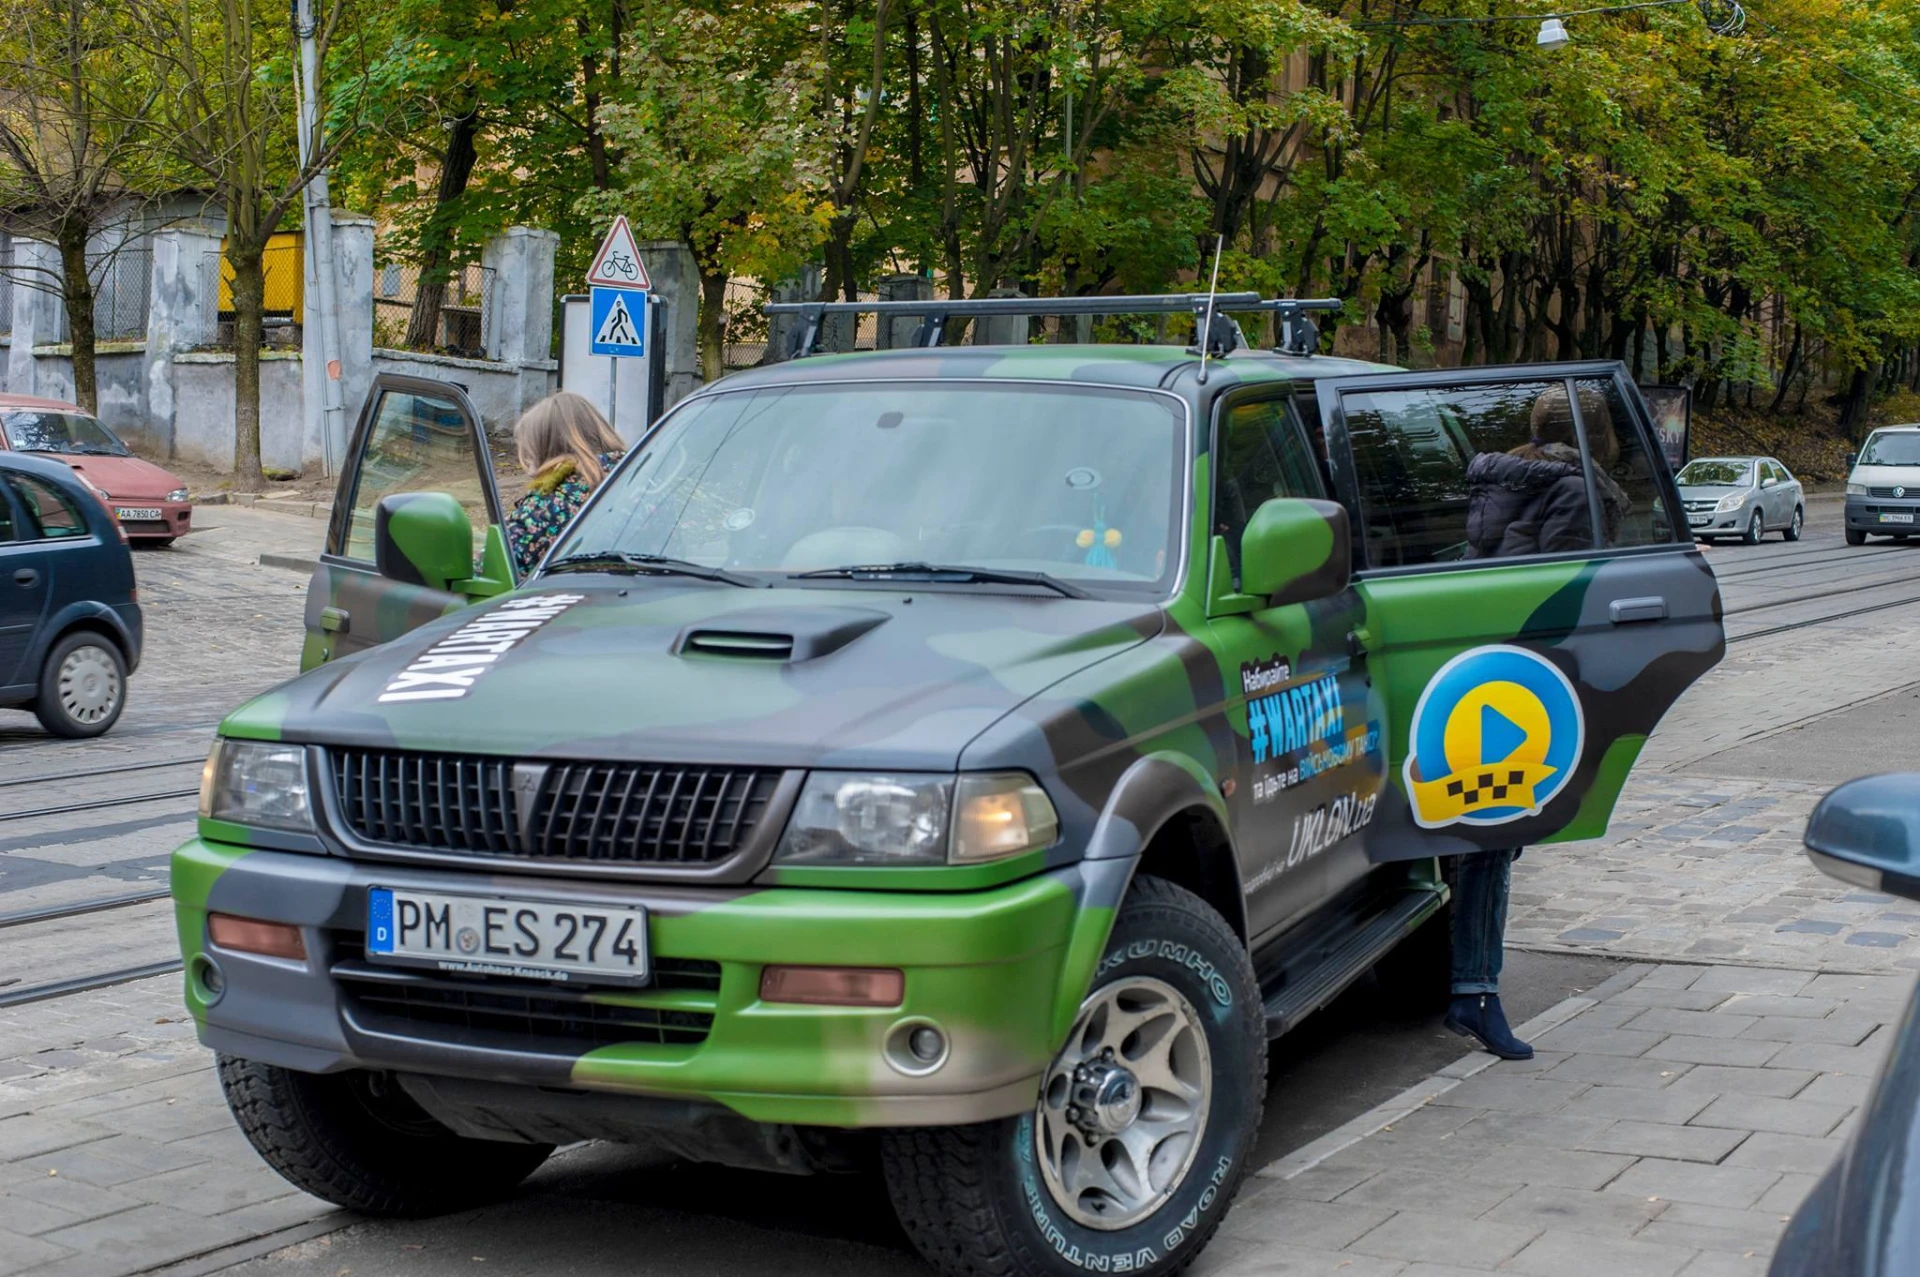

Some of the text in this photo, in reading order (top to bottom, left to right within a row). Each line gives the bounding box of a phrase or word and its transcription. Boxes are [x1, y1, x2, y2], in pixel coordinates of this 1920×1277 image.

[1656, 427, 1680, 444] SKY
[121, 509, 131, 518] AA
[132, 509, 149, 518] 7850
[378, 594, 585, 702] #WARTAXI
[1242, 661, 1290, 693] Набирайте
[1249, 675, 1342, 765] #WARTAXI
[1288, 767, 1299, 786] на
[377, 928, 387, 941] D
[397, 899, 638, 965] PM ES 274
[1096, 939, 1232, 1006] KUMHO
[1023, 1175, 1157, 1272] VENTURE
[1163, 1156, 1232, 1250] ROAD
